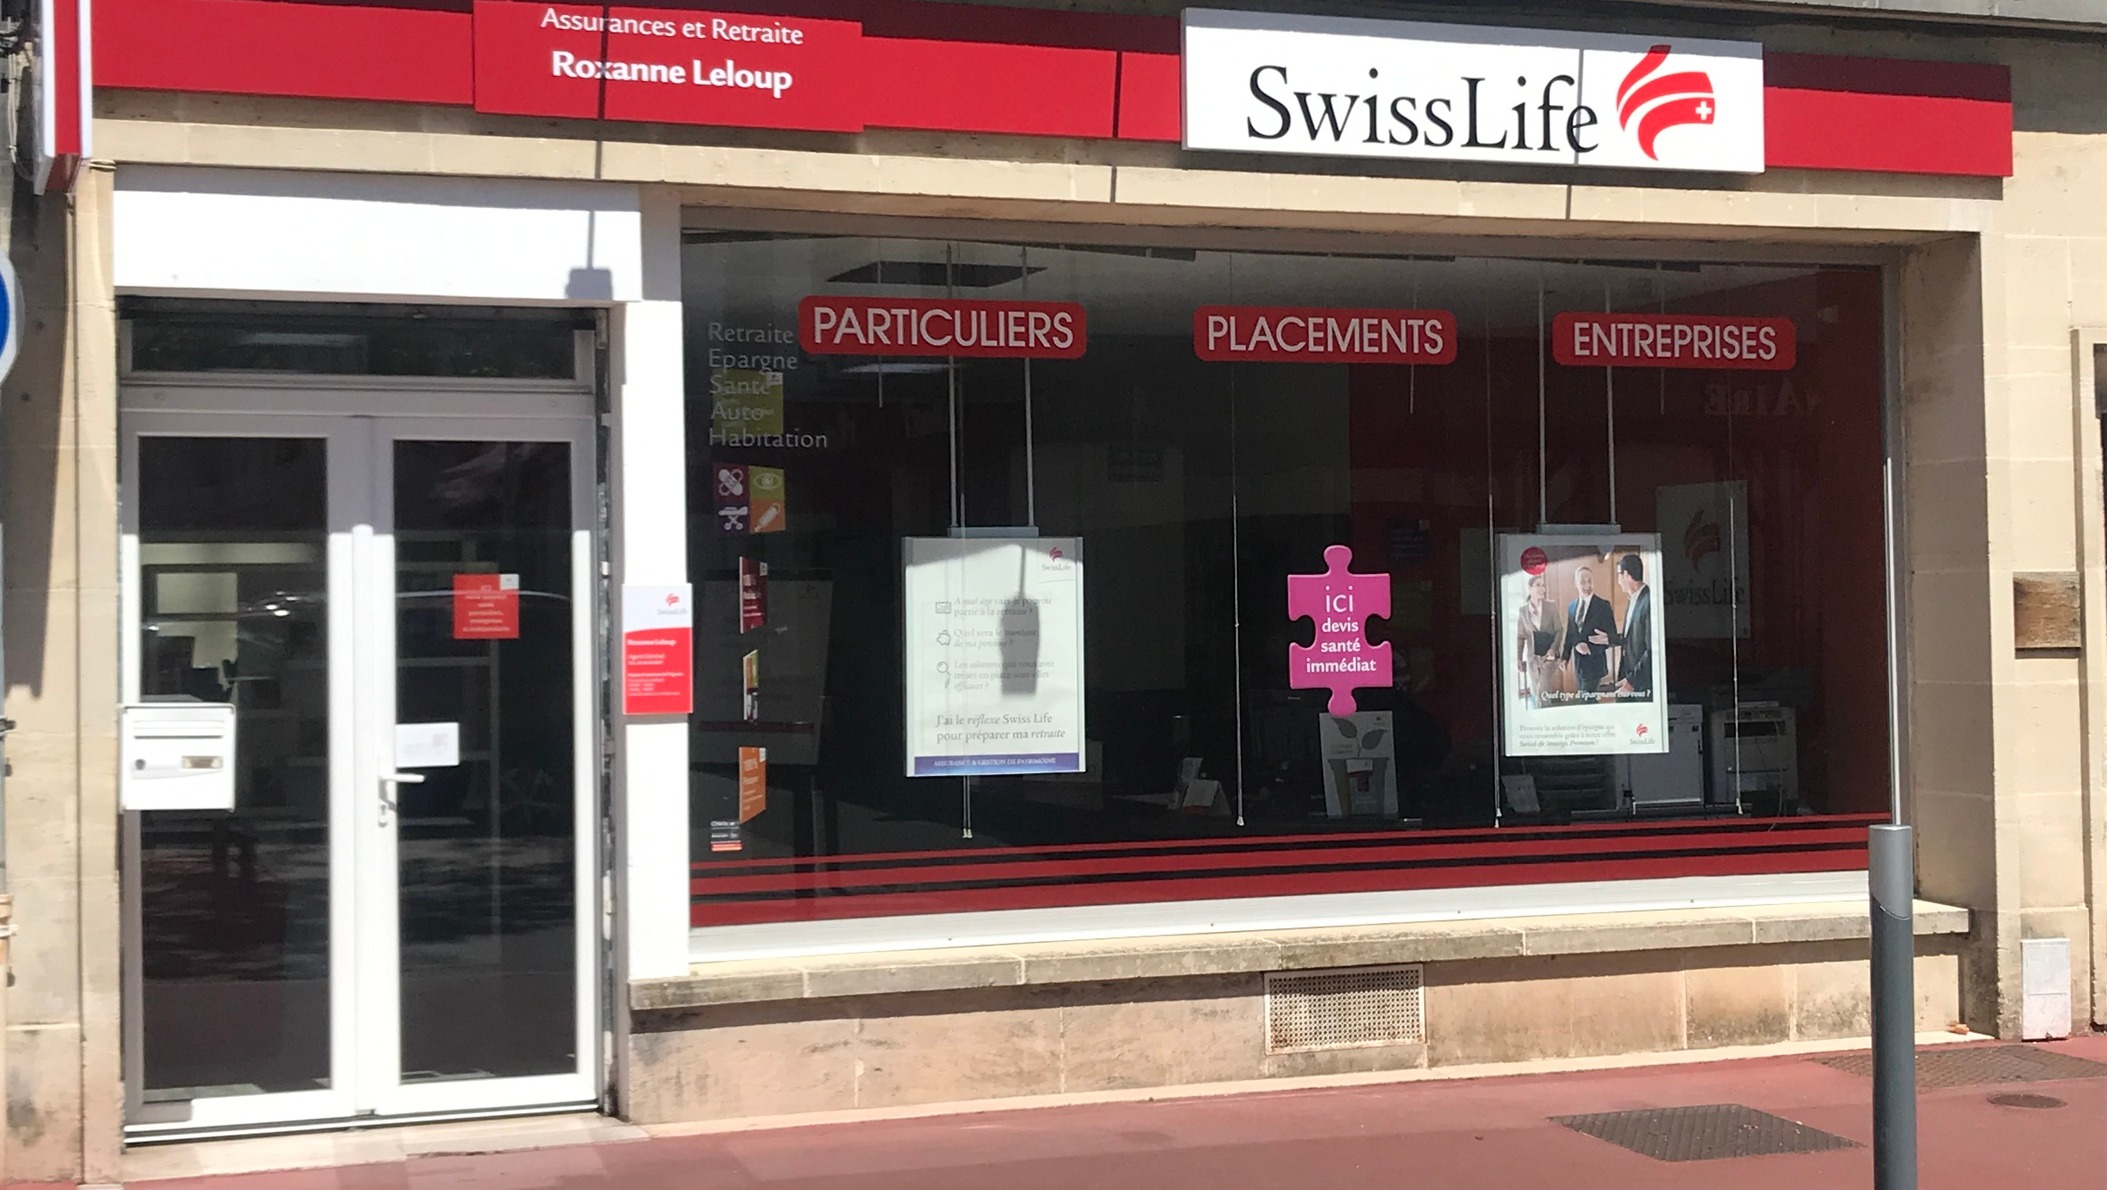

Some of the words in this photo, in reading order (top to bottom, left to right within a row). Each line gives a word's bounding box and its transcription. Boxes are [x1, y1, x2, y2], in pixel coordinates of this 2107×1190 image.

[540, 7, 676, 37] Assurances
[682, 21, 705, 38] et
[712, 18, 803, 44] Retraite
[552, 50, 685, 84] Roxanne
[693, 59, 793, 99] Leloup
[1247, 65, 1599, 153] SwissLife
[708, 322, 794, 344] Retraite
[814, 307, 1074, 348] PARTICULIERS
[1208, 315, 1443, 354] PLACEMENTS
[1574, 322, 1776, 360] ENTREPRISES
[708, 349, 798, 375] Epargne
[711, 402, 764, 421] Auto
[708, 427, 828, 448] Habitation
[1325, 585, 1354, 613] ici
[1321, 617, 1359, 633] devis
[1321, 638, 1361, 653] santé
[1306, 657, 1377, 673] immédiat
[1541, 690, 1559, 701] Quel
[935, 714, 953, 727] J'ai
[956, 714, 965, 725] le
[967, 713, 1000, 727] réflexe
[1002, 713, 1031, 724] Swiss
[1033, 712, 1052, 724] Life
[936, 734, 962, 744] pour
[965, 731, 1009, 744] préparer
[1012, 731, 1028, 739] ma
[1031, 729, 1066, 739] retraite
